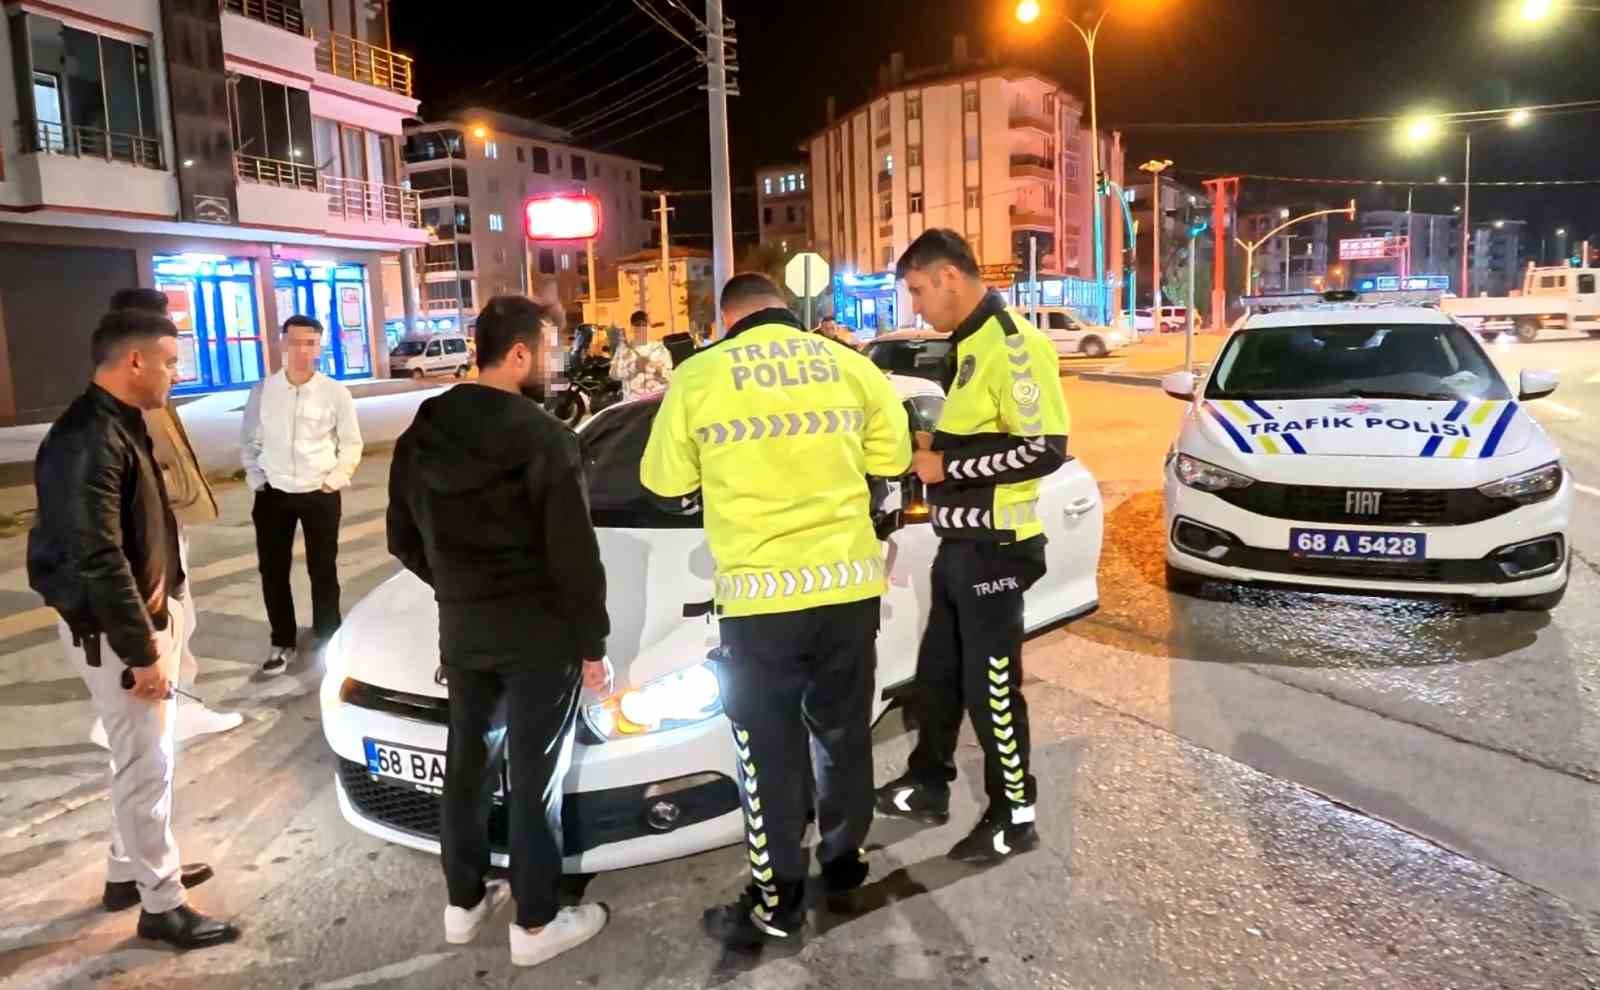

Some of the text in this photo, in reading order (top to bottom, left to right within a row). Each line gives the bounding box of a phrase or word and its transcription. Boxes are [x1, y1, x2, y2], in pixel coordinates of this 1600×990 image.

[731, 358, 840, 391] POLİSİ
[1345, 490, 1383, 514] FIAT
[1298, 533, 1416, 555] 68 A 5428
[377, 747, 402, 775] 68
